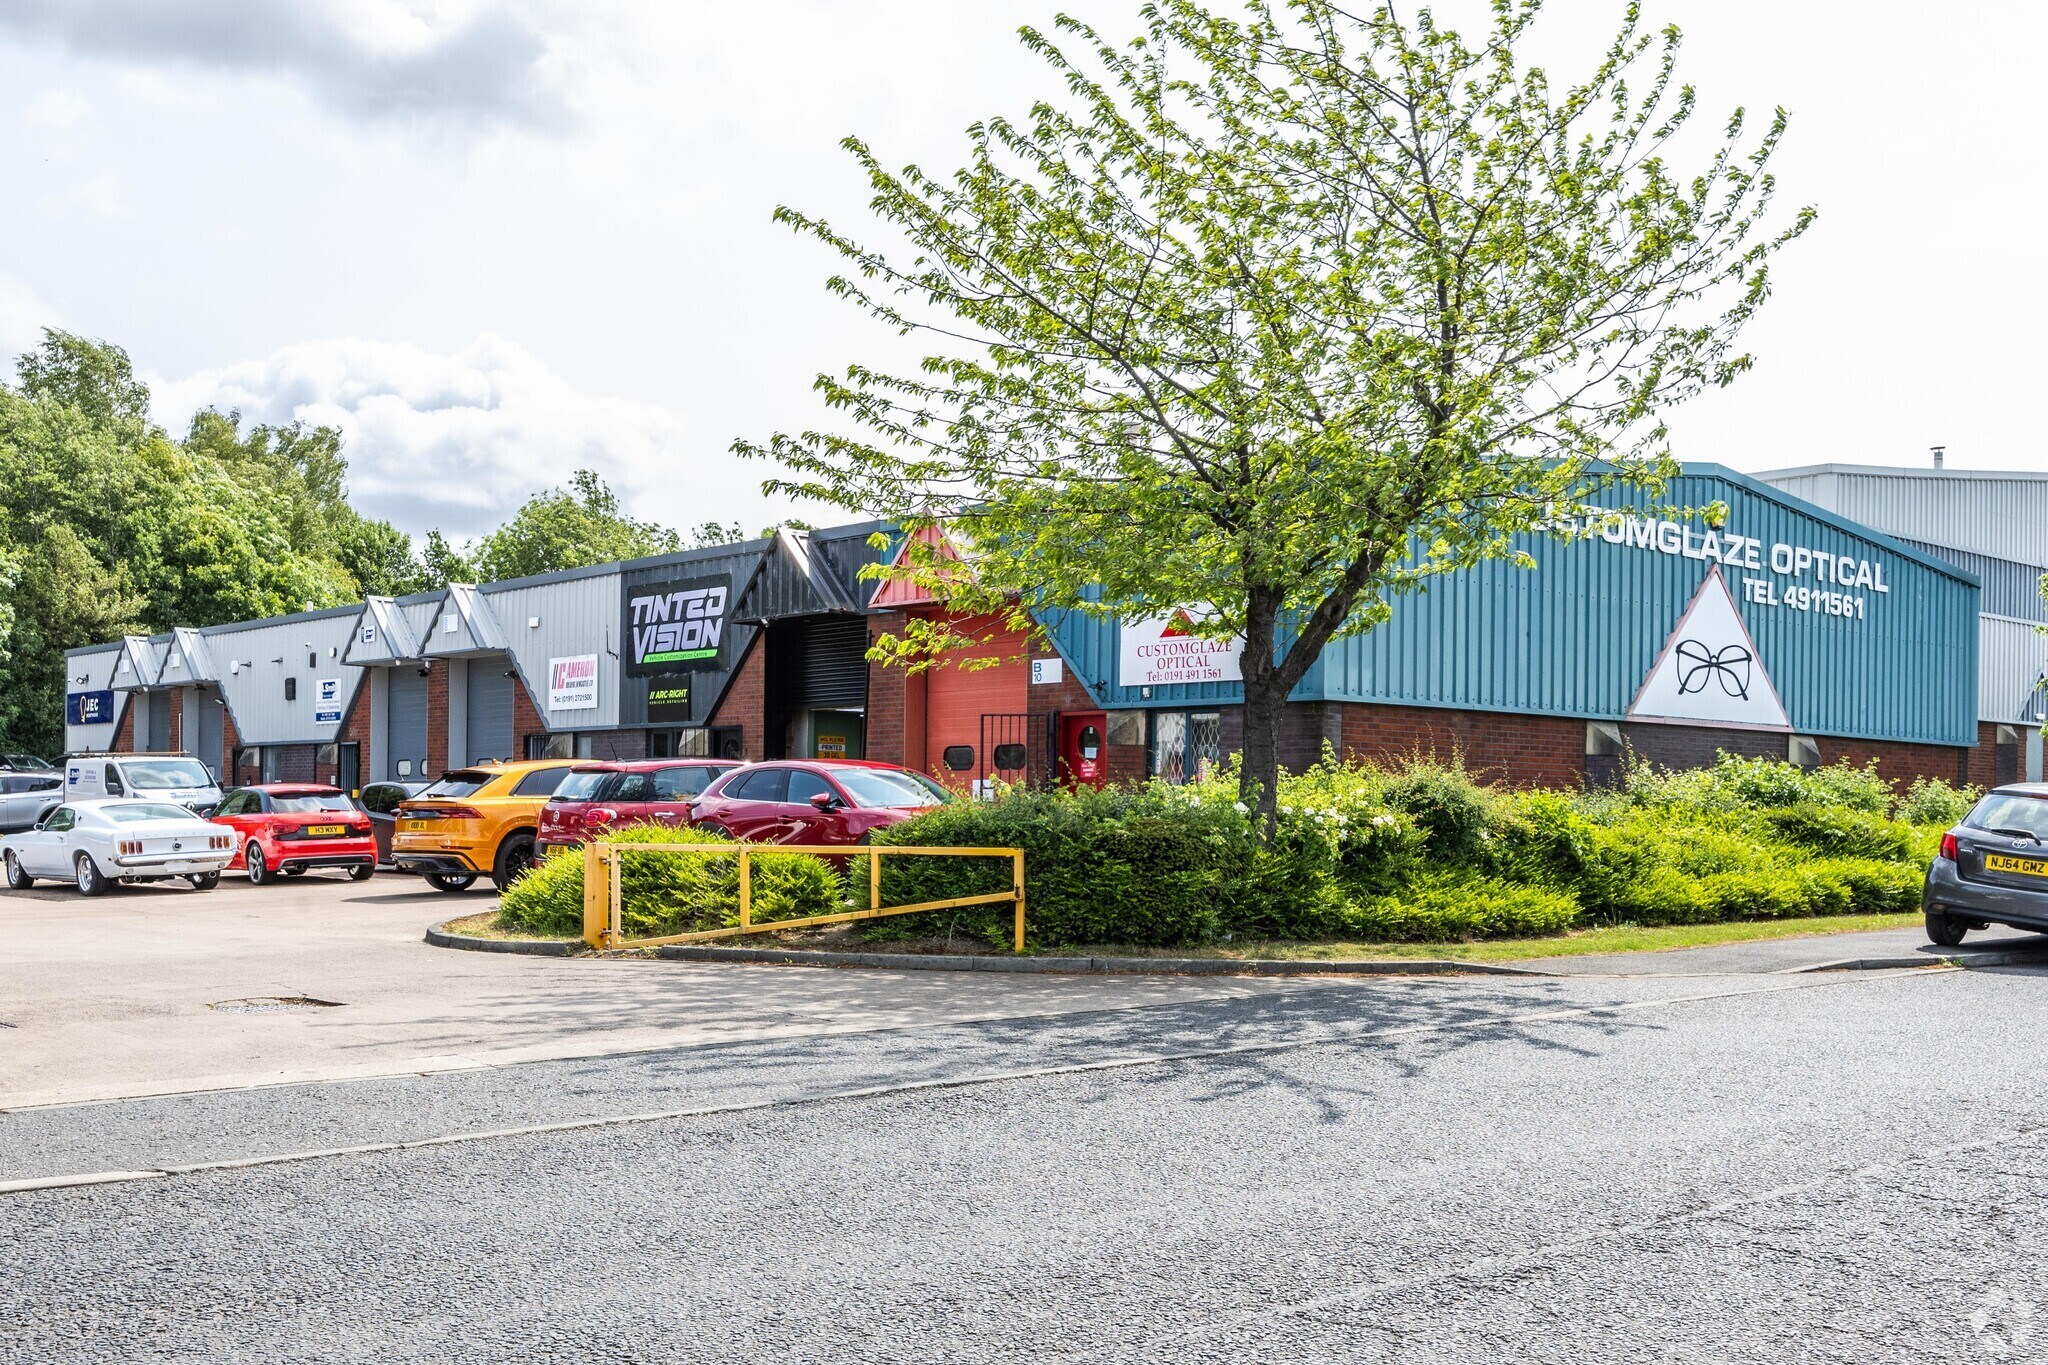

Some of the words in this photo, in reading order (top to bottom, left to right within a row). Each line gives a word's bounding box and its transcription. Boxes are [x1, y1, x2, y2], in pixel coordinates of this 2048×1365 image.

[1771, 543, 1889, 593] OPTICAL
[630, 586, 727, 625] TINTED
[1742, 577, 1778, 606] TEL
[1783, 585, 1863, 620] 4911561
[633, 618, 723, 664] VISION
[1137, 640, 1232, 658] CUSTOMGLAZE
[1033, 662, 1042, 673] B
[1157, 655, 1210, 670] OPTICAL
[1033, 673, 1042, 682] 10
[1146, 670, 1163, 682] Tel:
[1164, 670, 1183, 681] 0191
[1185, 669, 1200, 680] 491
[1203, 668, 1222, 679] 1561
[655, 689, 688, 699] ARC-RIGHT
[86, 698, 99, 711] JEC
[1990, 857, 2019, 869] NJ64
[2022, 861, 2045, 873] GMZ
